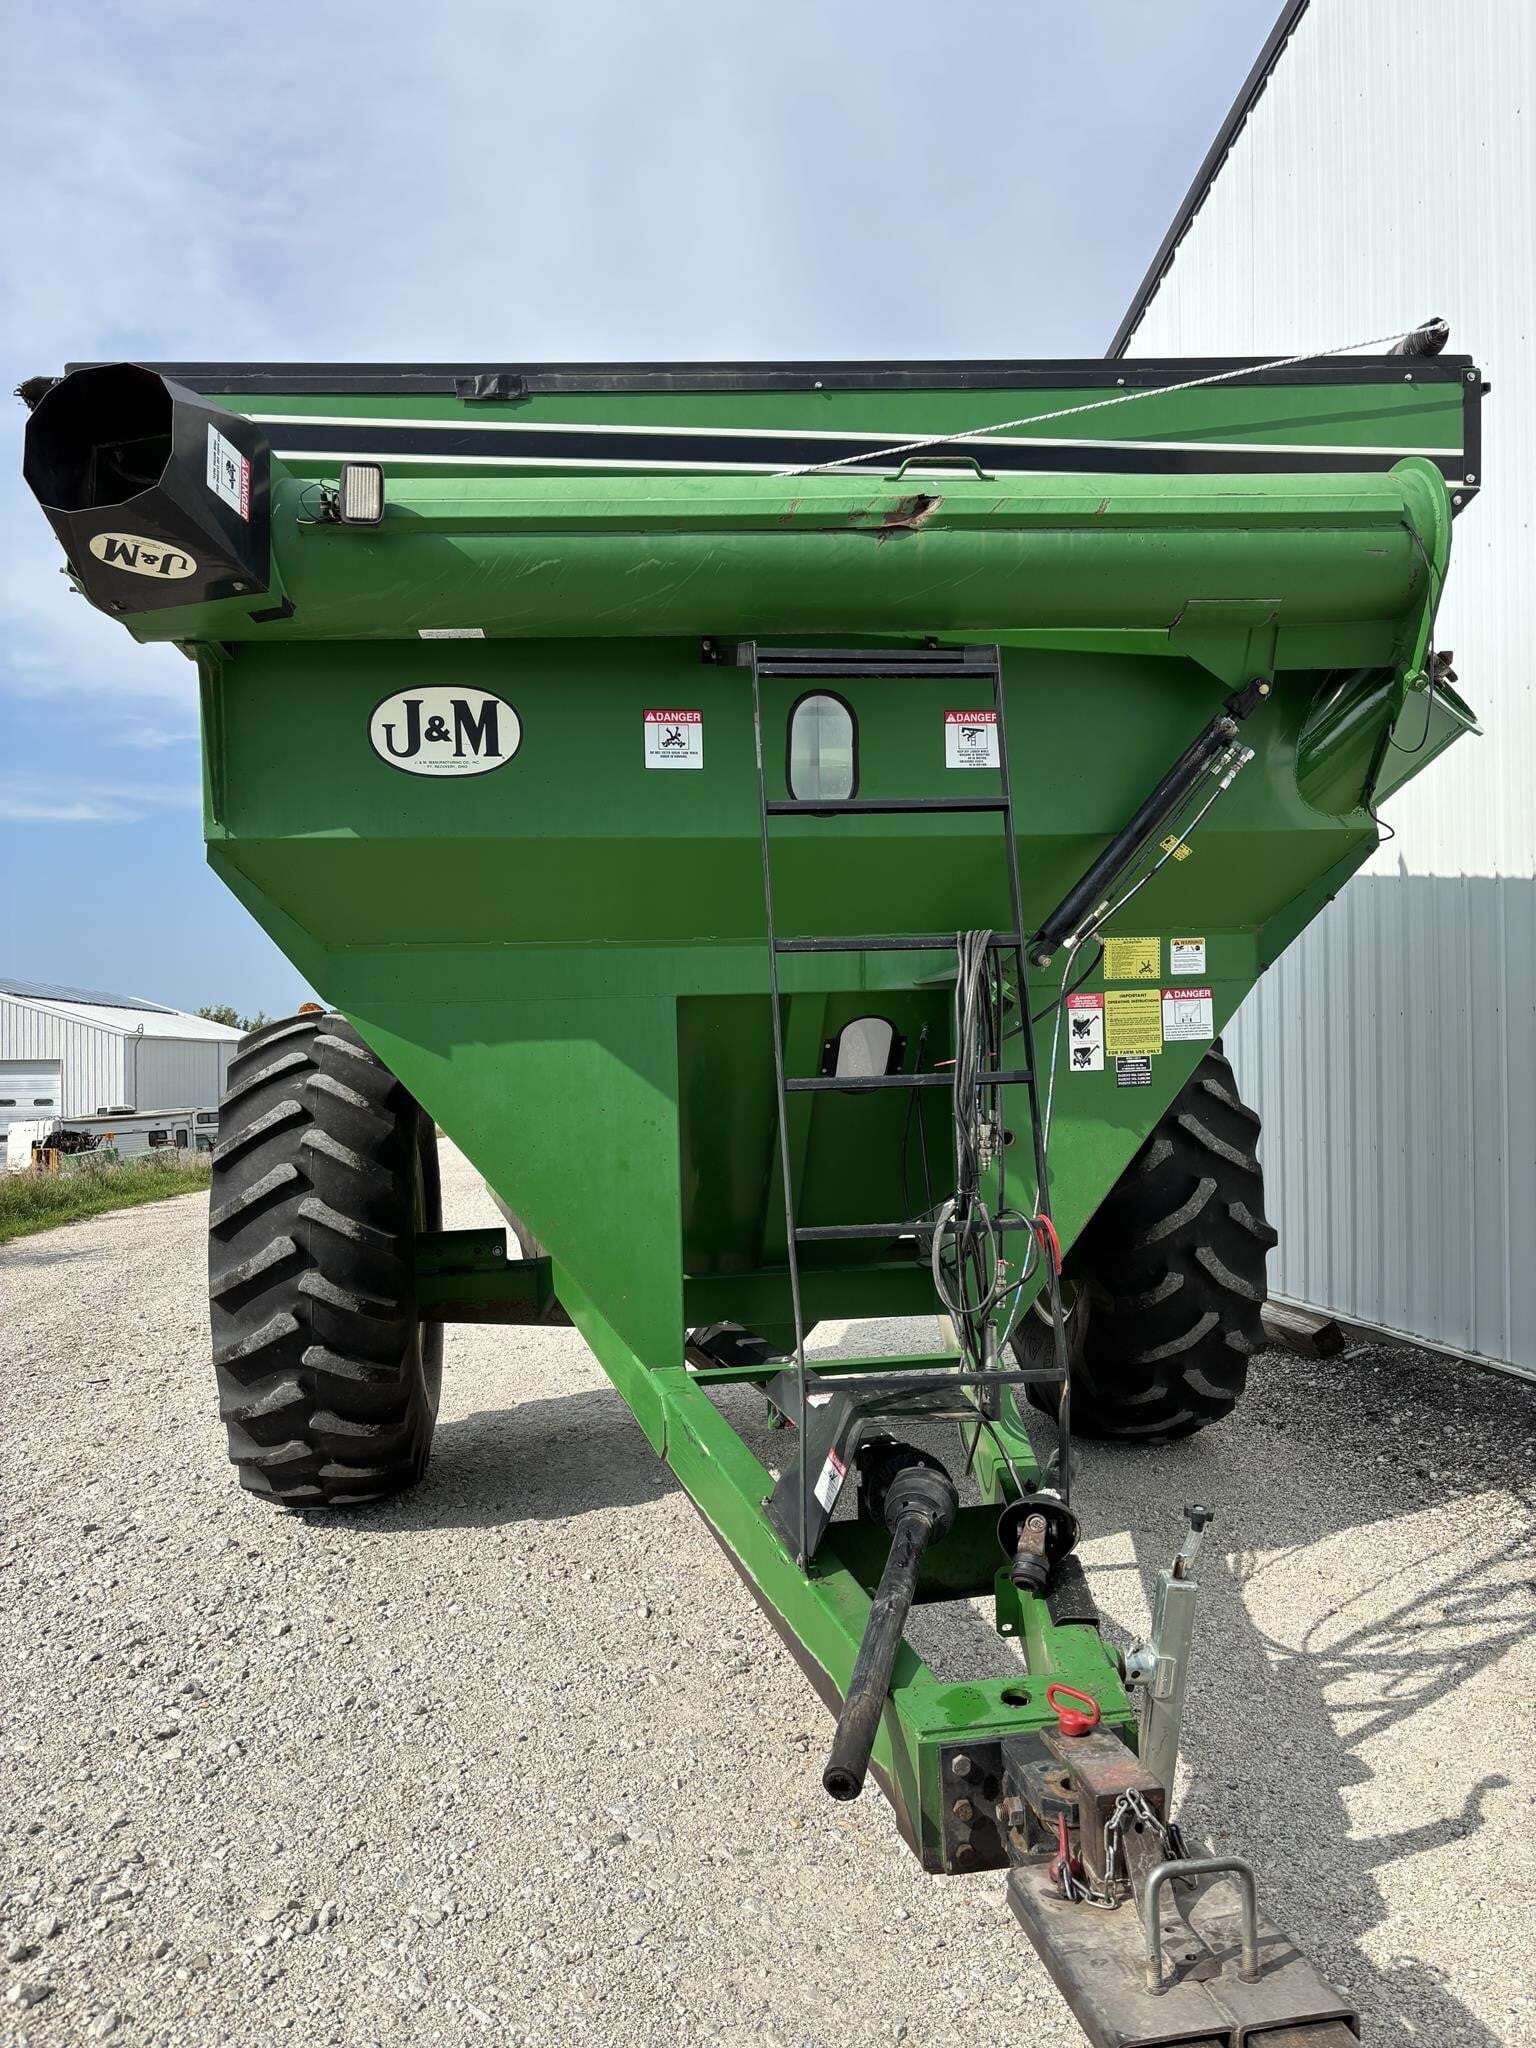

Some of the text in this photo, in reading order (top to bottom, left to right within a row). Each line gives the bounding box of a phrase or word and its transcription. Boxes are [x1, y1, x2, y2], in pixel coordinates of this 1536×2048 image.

[241, 468, 250, 520] DANGER
[103, 537, 188, 576] J&M
[382, 699, 503, 758] J&M
[656, 712, 701, 721] DANGER
[1174, 990, 1211, 998] DANGER
